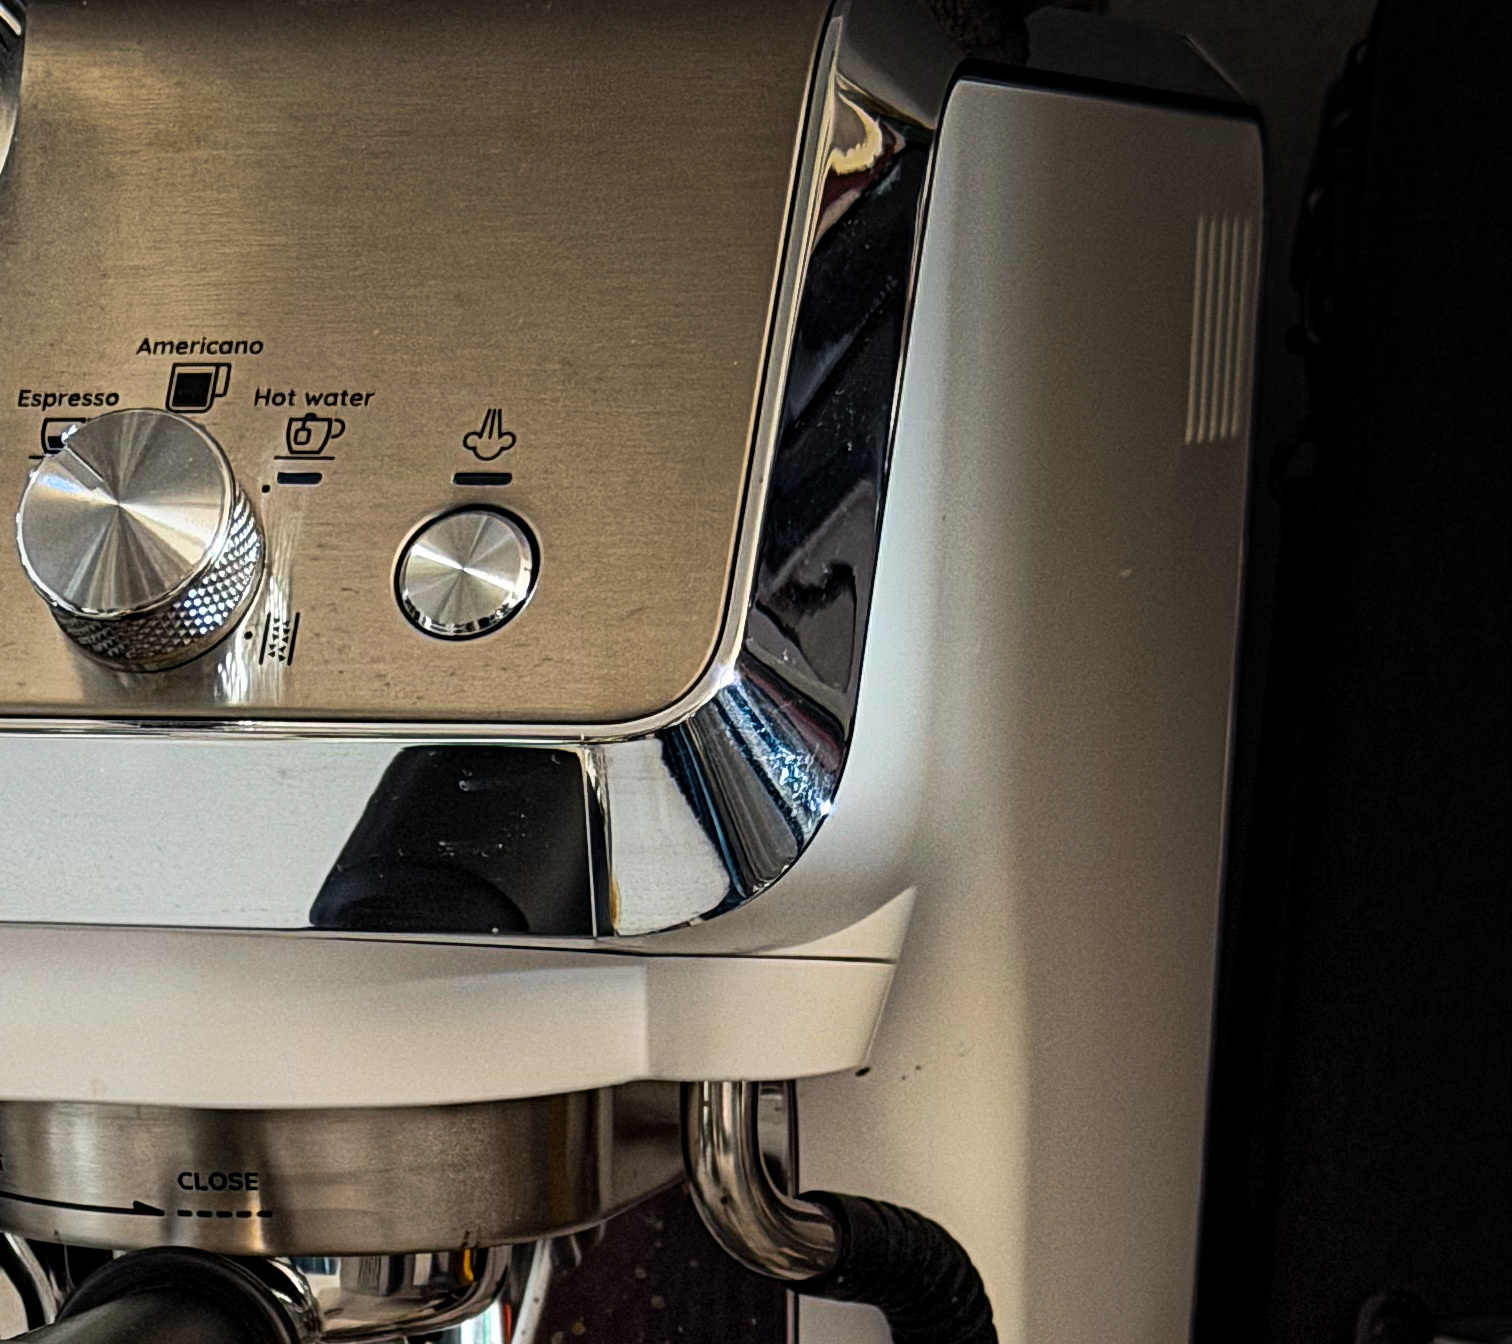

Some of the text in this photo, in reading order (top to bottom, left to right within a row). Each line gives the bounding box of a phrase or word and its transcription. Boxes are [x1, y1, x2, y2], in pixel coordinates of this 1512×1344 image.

[136, 337, 264, 356] Americano
[17, 388, 120, 410] Espresso
[253, 387, 375, 408] Hot water
[176, 1171, 260, 1192] CLOSE
